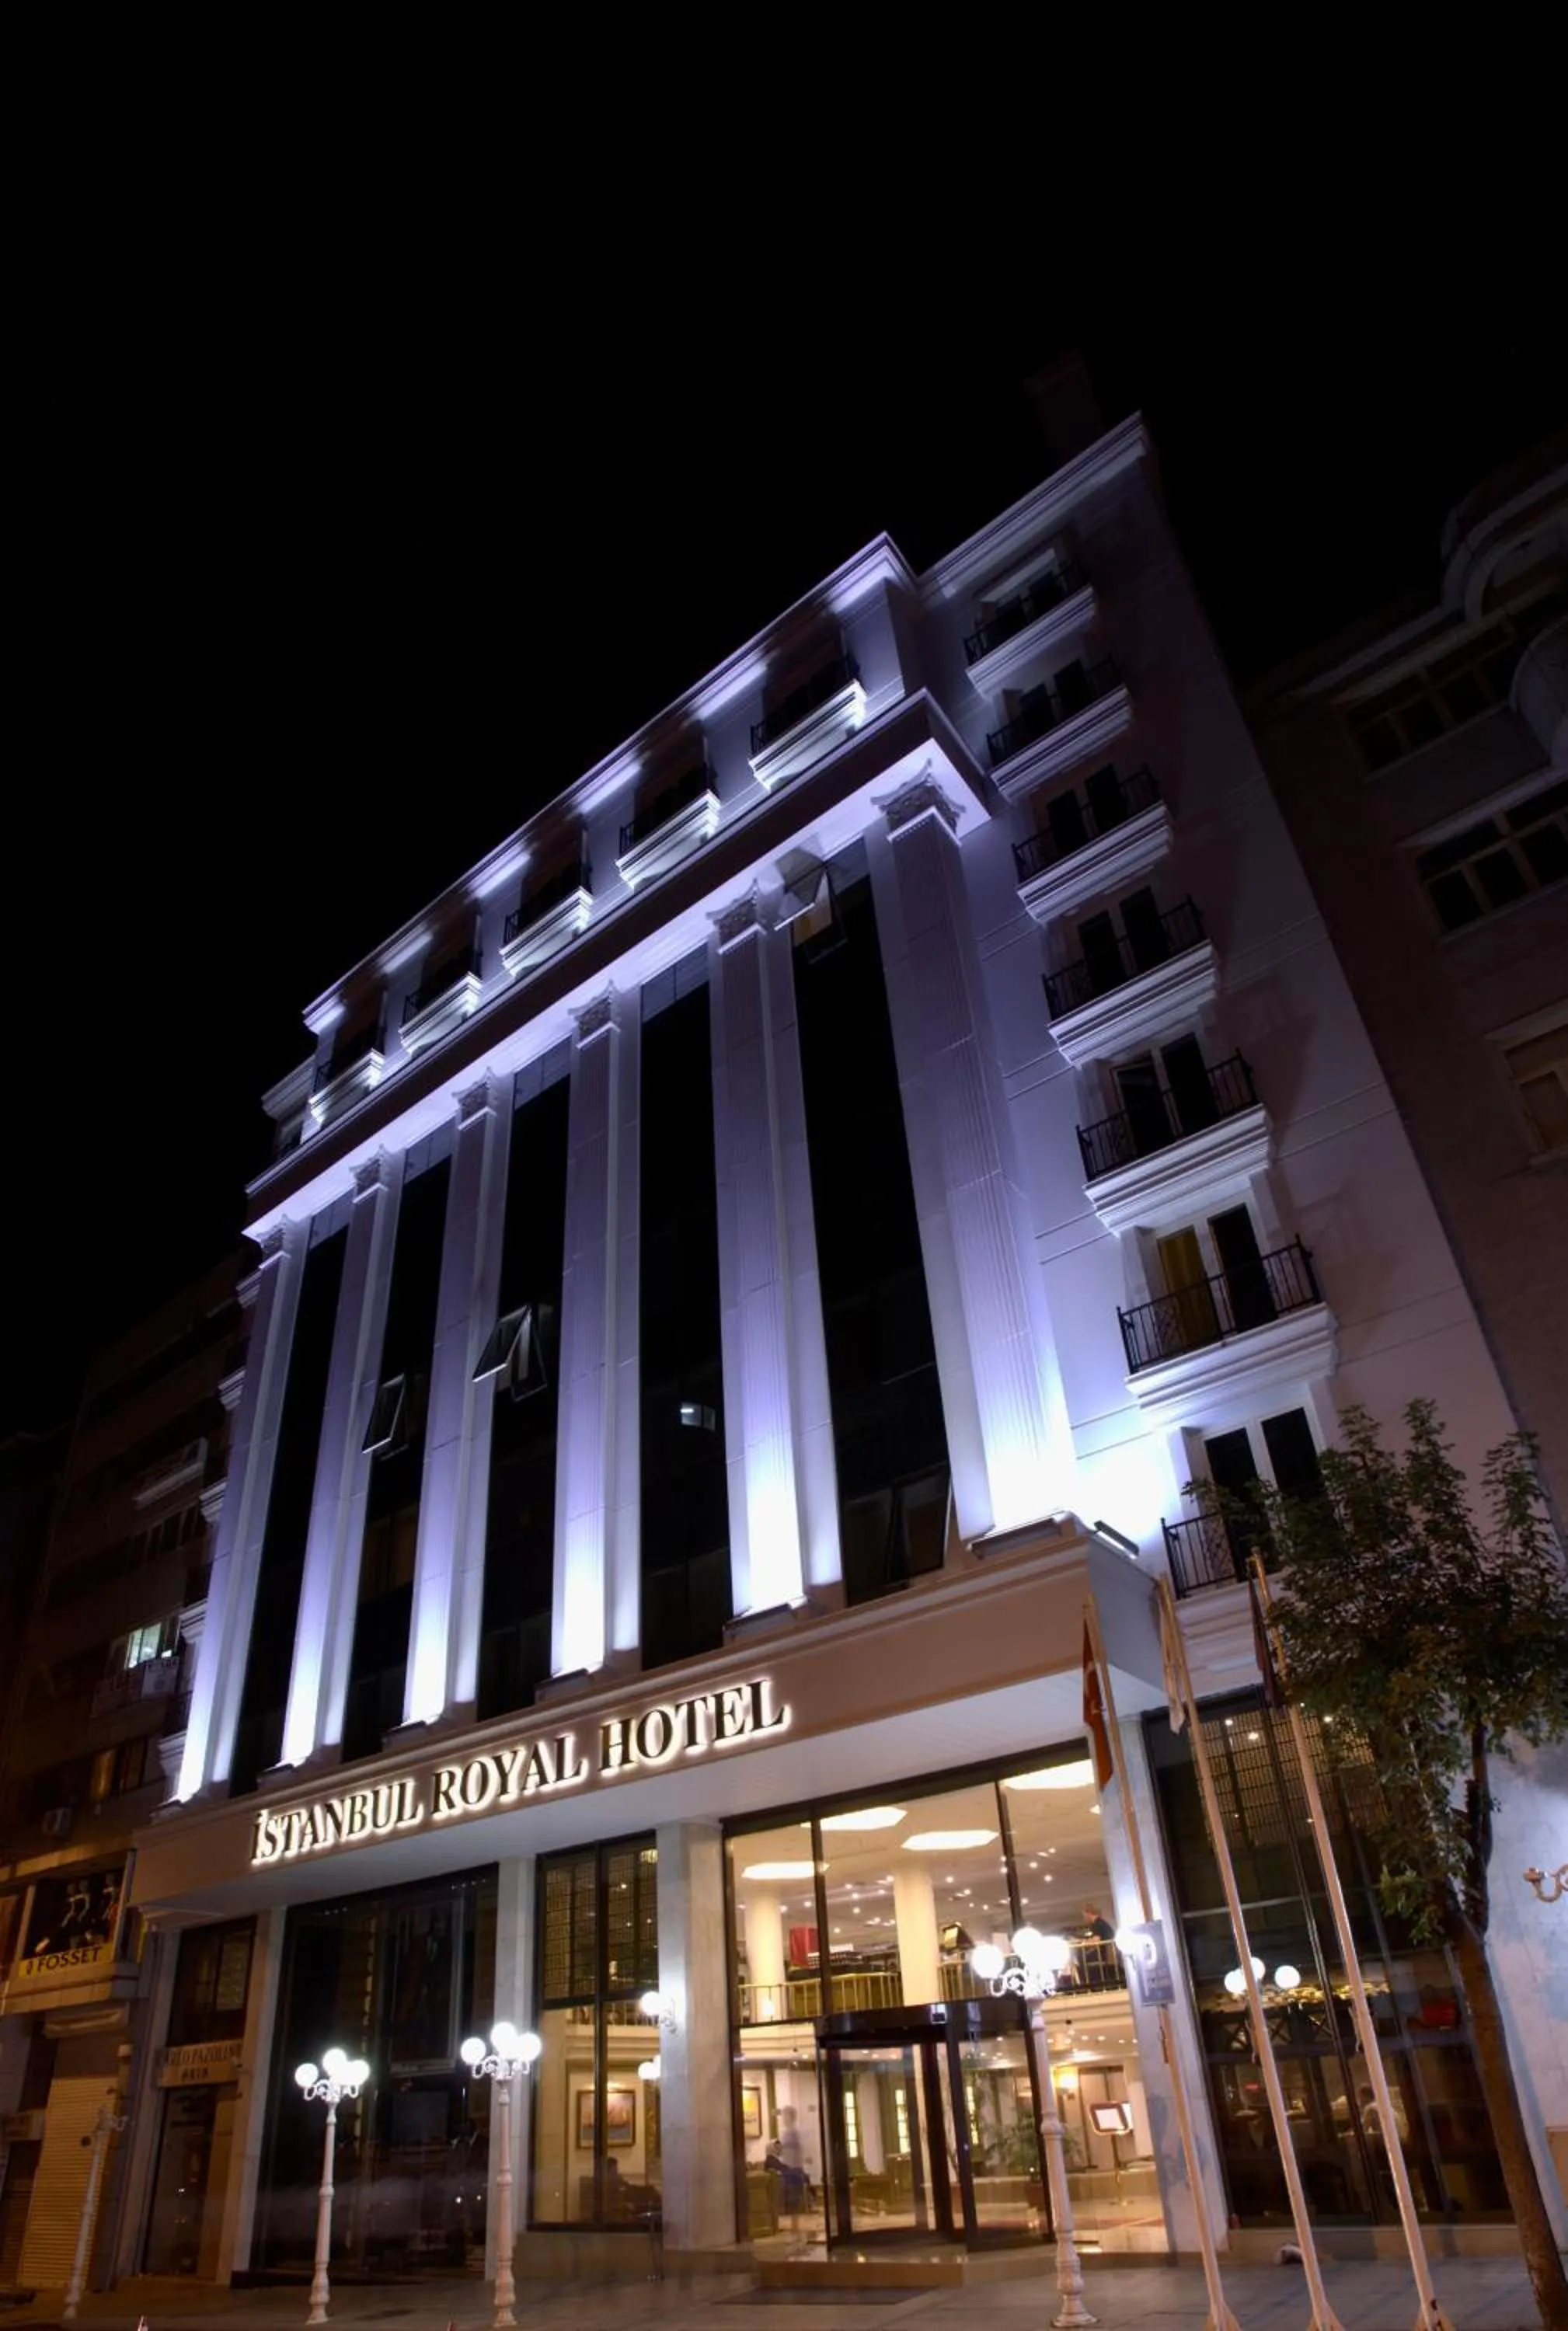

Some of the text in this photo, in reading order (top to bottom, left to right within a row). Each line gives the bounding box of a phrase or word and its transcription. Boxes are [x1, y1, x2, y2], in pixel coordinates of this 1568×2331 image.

[250, 1679, 788, 1861] İSTANBUL ROYAL HOTEL
